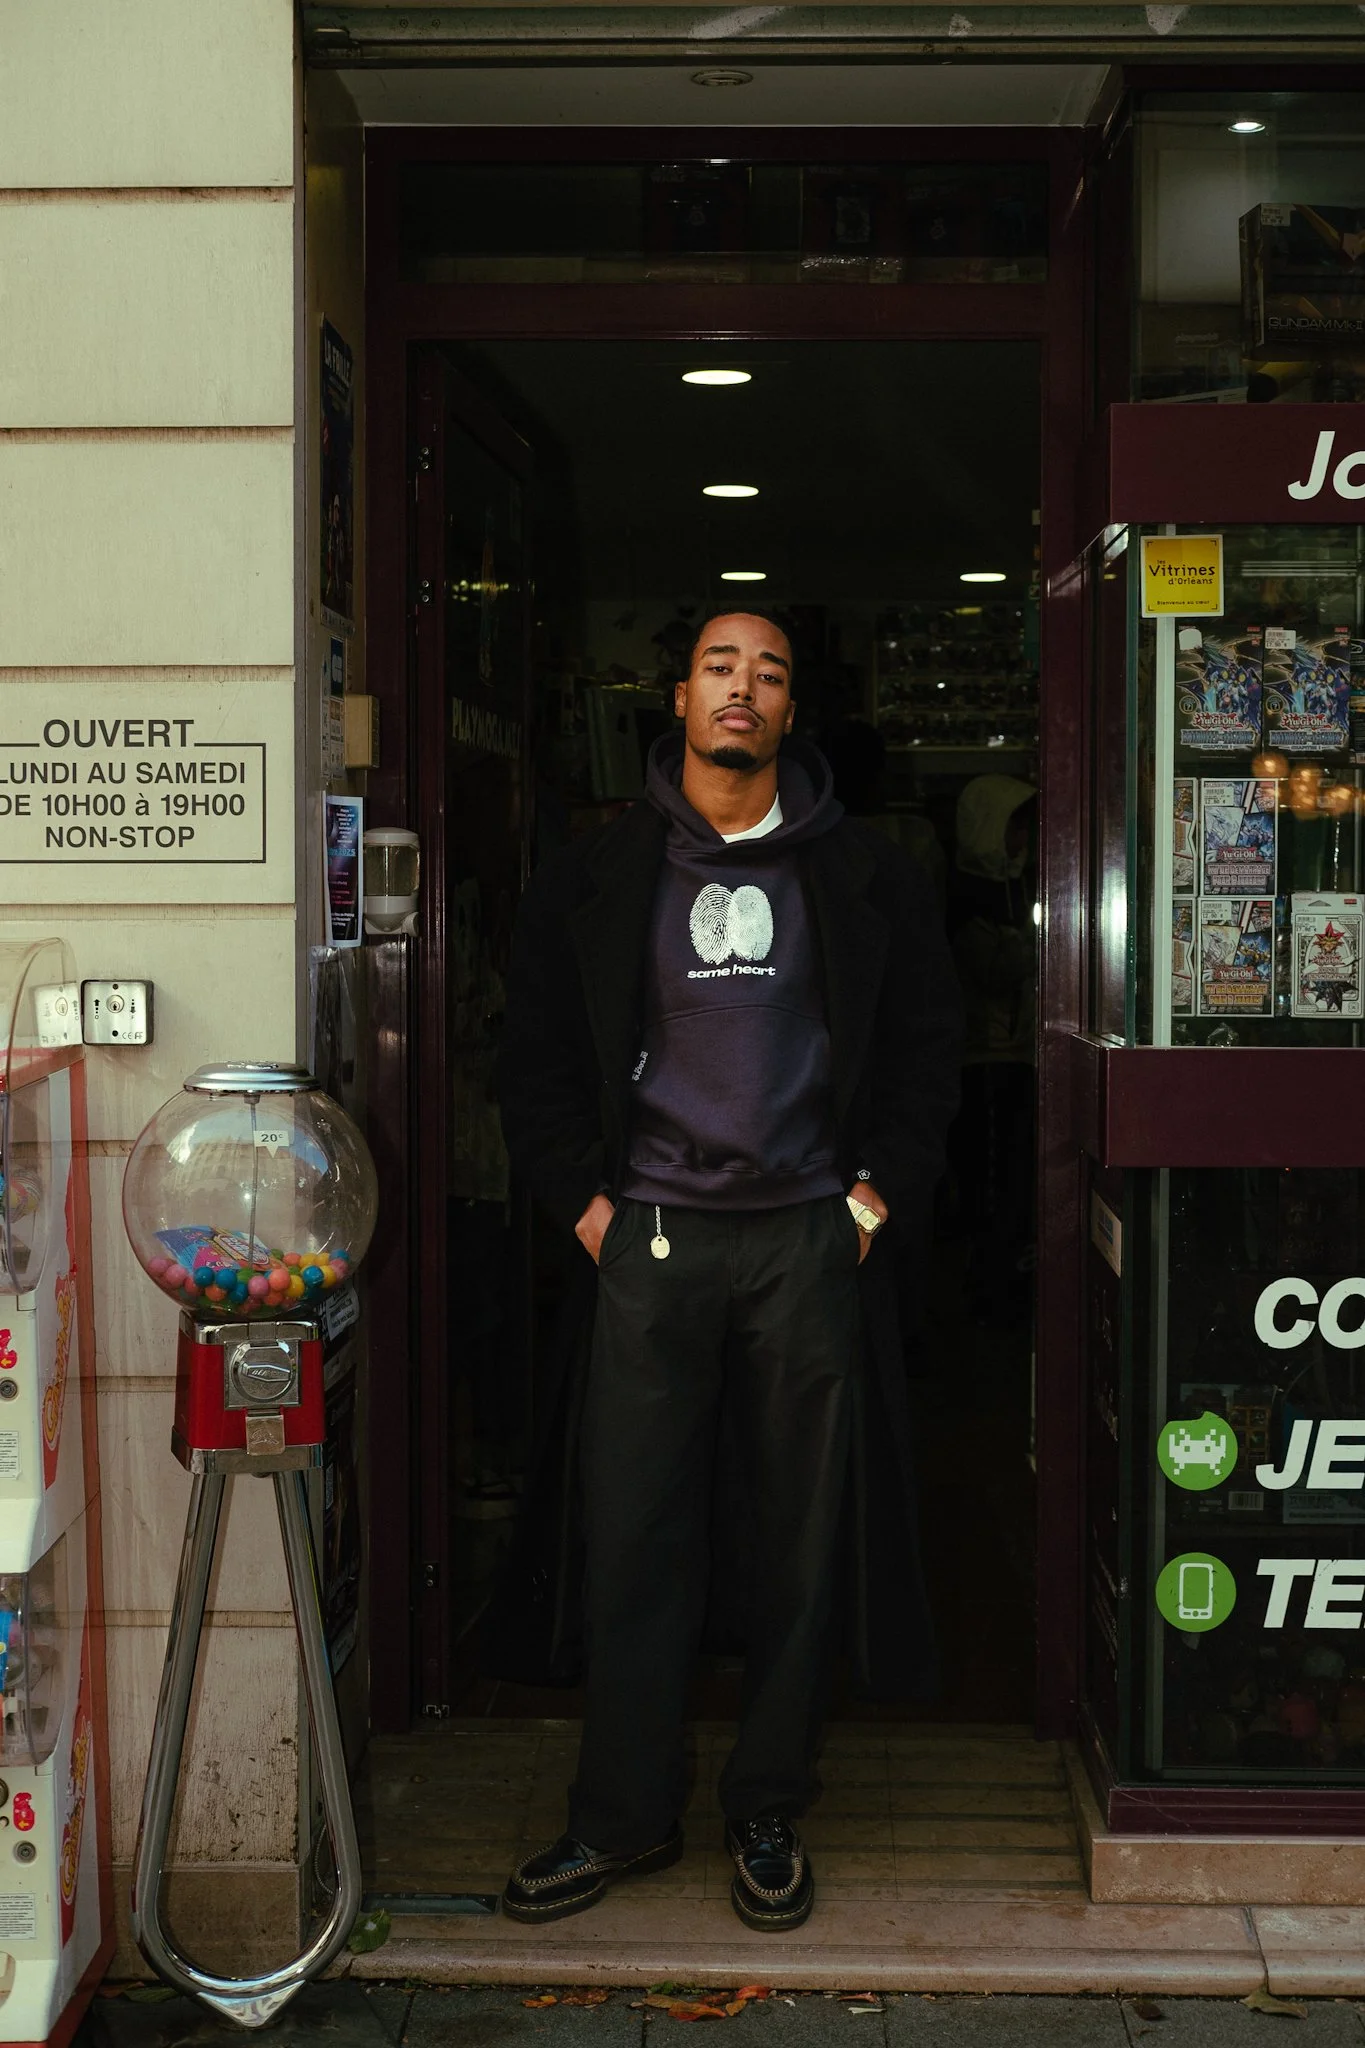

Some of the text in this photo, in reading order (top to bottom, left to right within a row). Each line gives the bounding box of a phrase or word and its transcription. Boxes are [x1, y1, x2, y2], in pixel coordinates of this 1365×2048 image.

[1268, 316, 1332, 329] GUNDAM
[1149, 564, 1216, 577] Vitrines
[1168, 577, 1213, 585] d'Orléans
[43, 719, 195, 748] OUVERT
[87, 762, 126, 784] AU
[136, 761, 246, 785] SAMEDI
[42, 793, 126, 816] 10H00
[135, 792, 150, 816] à
[161, 793, 246, 816] 19H00
[45, 826, 195, 848] NON-STOP
[687, 964, 776, 979] same heart
[1254, 1276, 1365, 1350] CO
[1255, 1419, 1365, 1490] JE
